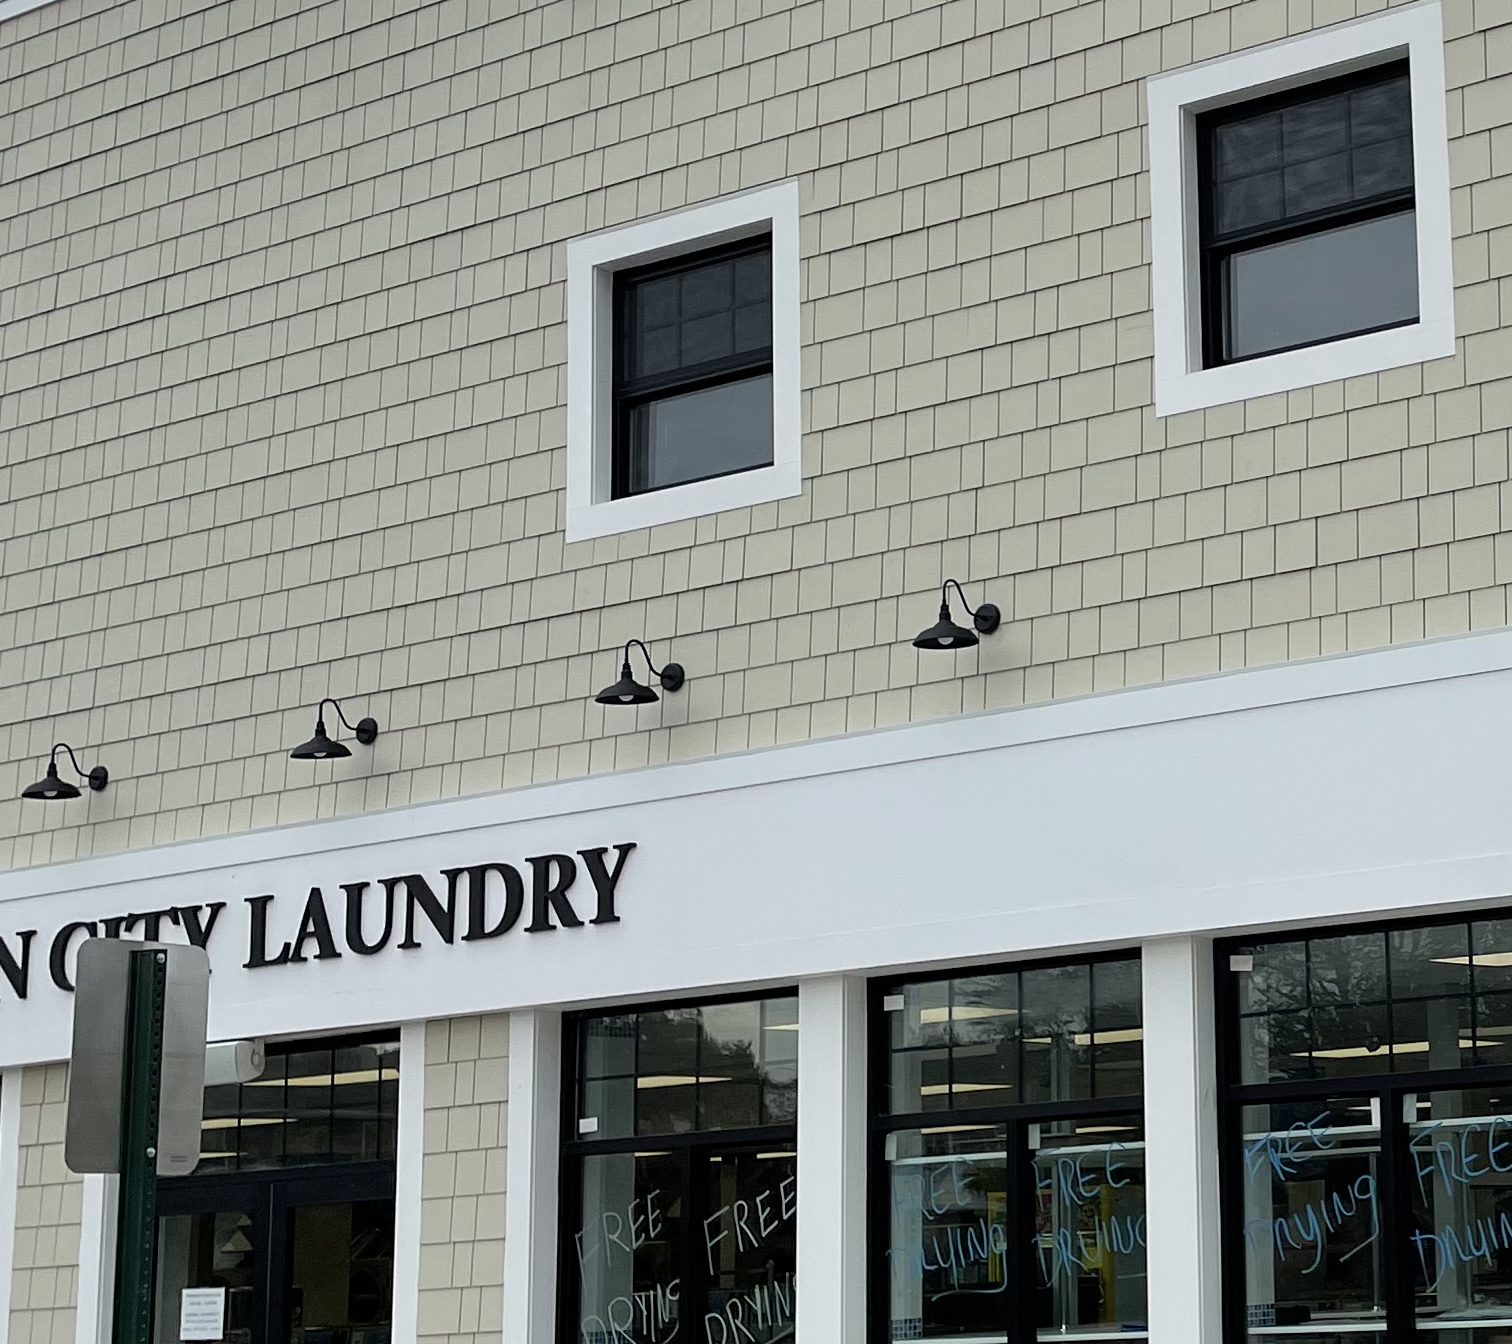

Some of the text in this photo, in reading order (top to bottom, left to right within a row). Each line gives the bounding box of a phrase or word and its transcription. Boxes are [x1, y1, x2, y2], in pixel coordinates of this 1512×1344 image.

[49, 902, 228, 992] CTY
[242, 841, 638, 970] LAUNDRY
[1031, 1142, 1130, 1214] FREE
[1244, 1111, 1337, 1186] FREE
[575, 1189, 662, 1296] FREE
[703, 1175, 797, 1276] FREE
